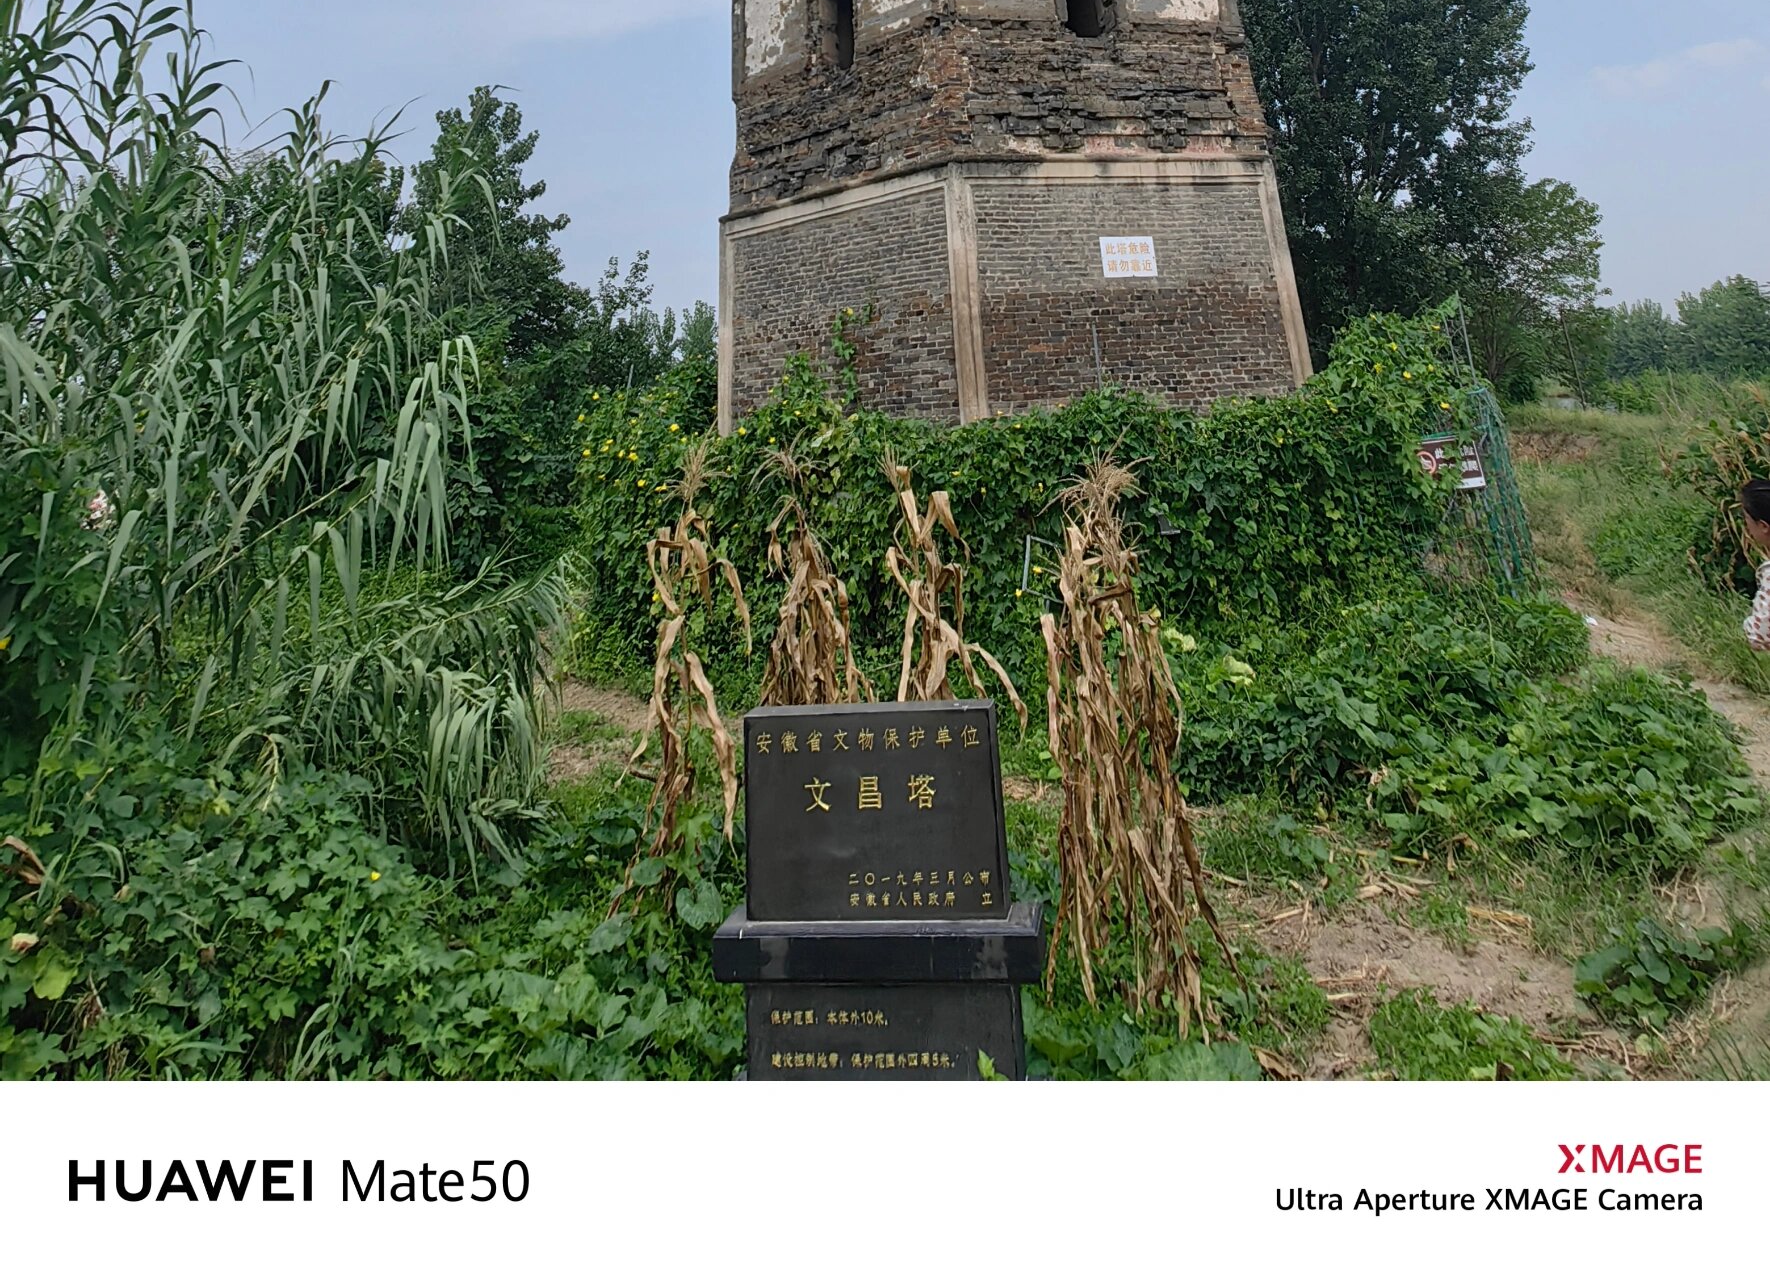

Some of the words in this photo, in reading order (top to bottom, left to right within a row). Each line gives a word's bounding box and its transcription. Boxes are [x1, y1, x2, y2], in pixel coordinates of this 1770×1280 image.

[1105, 241, 1150, 255] 此塔危险
[1107, 259, 1152, 272] 请勿靠近
[756, 724, 980, 754] 安徽省文物保护单位
[804, 775, 936, 812] 文昌塔
[850, 892, 956, 907] 安徽省人民政府
[982, 892, 993, 906] 立
